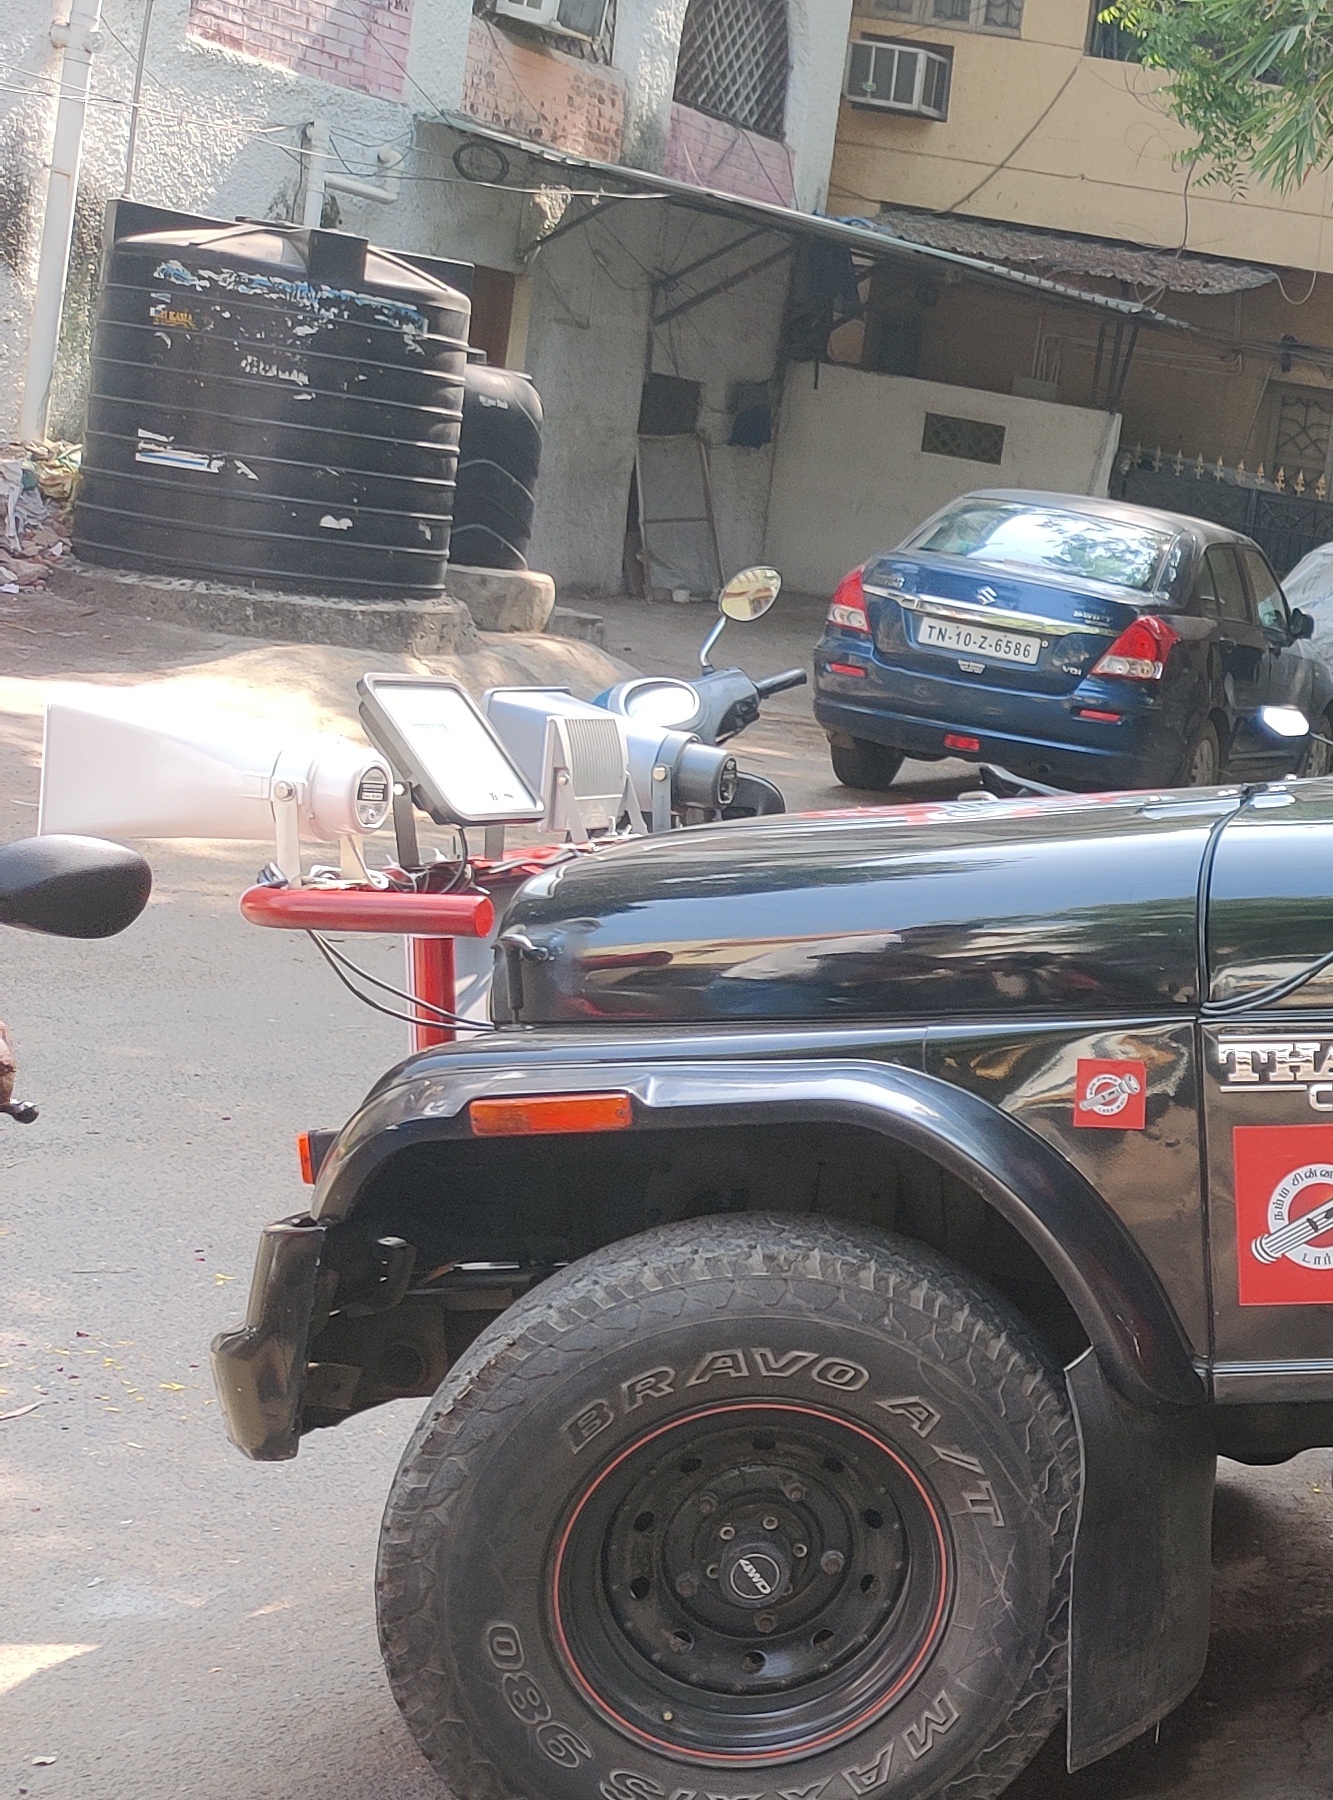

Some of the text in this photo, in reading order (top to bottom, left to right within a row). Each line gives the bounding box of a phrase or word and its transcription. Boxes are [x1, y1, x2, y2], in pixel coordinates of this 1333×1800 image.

[927, 624, 1032, 659] TN-10-Z-6586
[558, 1346, 1005, 1529] BRAVO A/T
[739, 1559, 771, 1594] 4WD
[484, 1622, 593, 1769] 980
